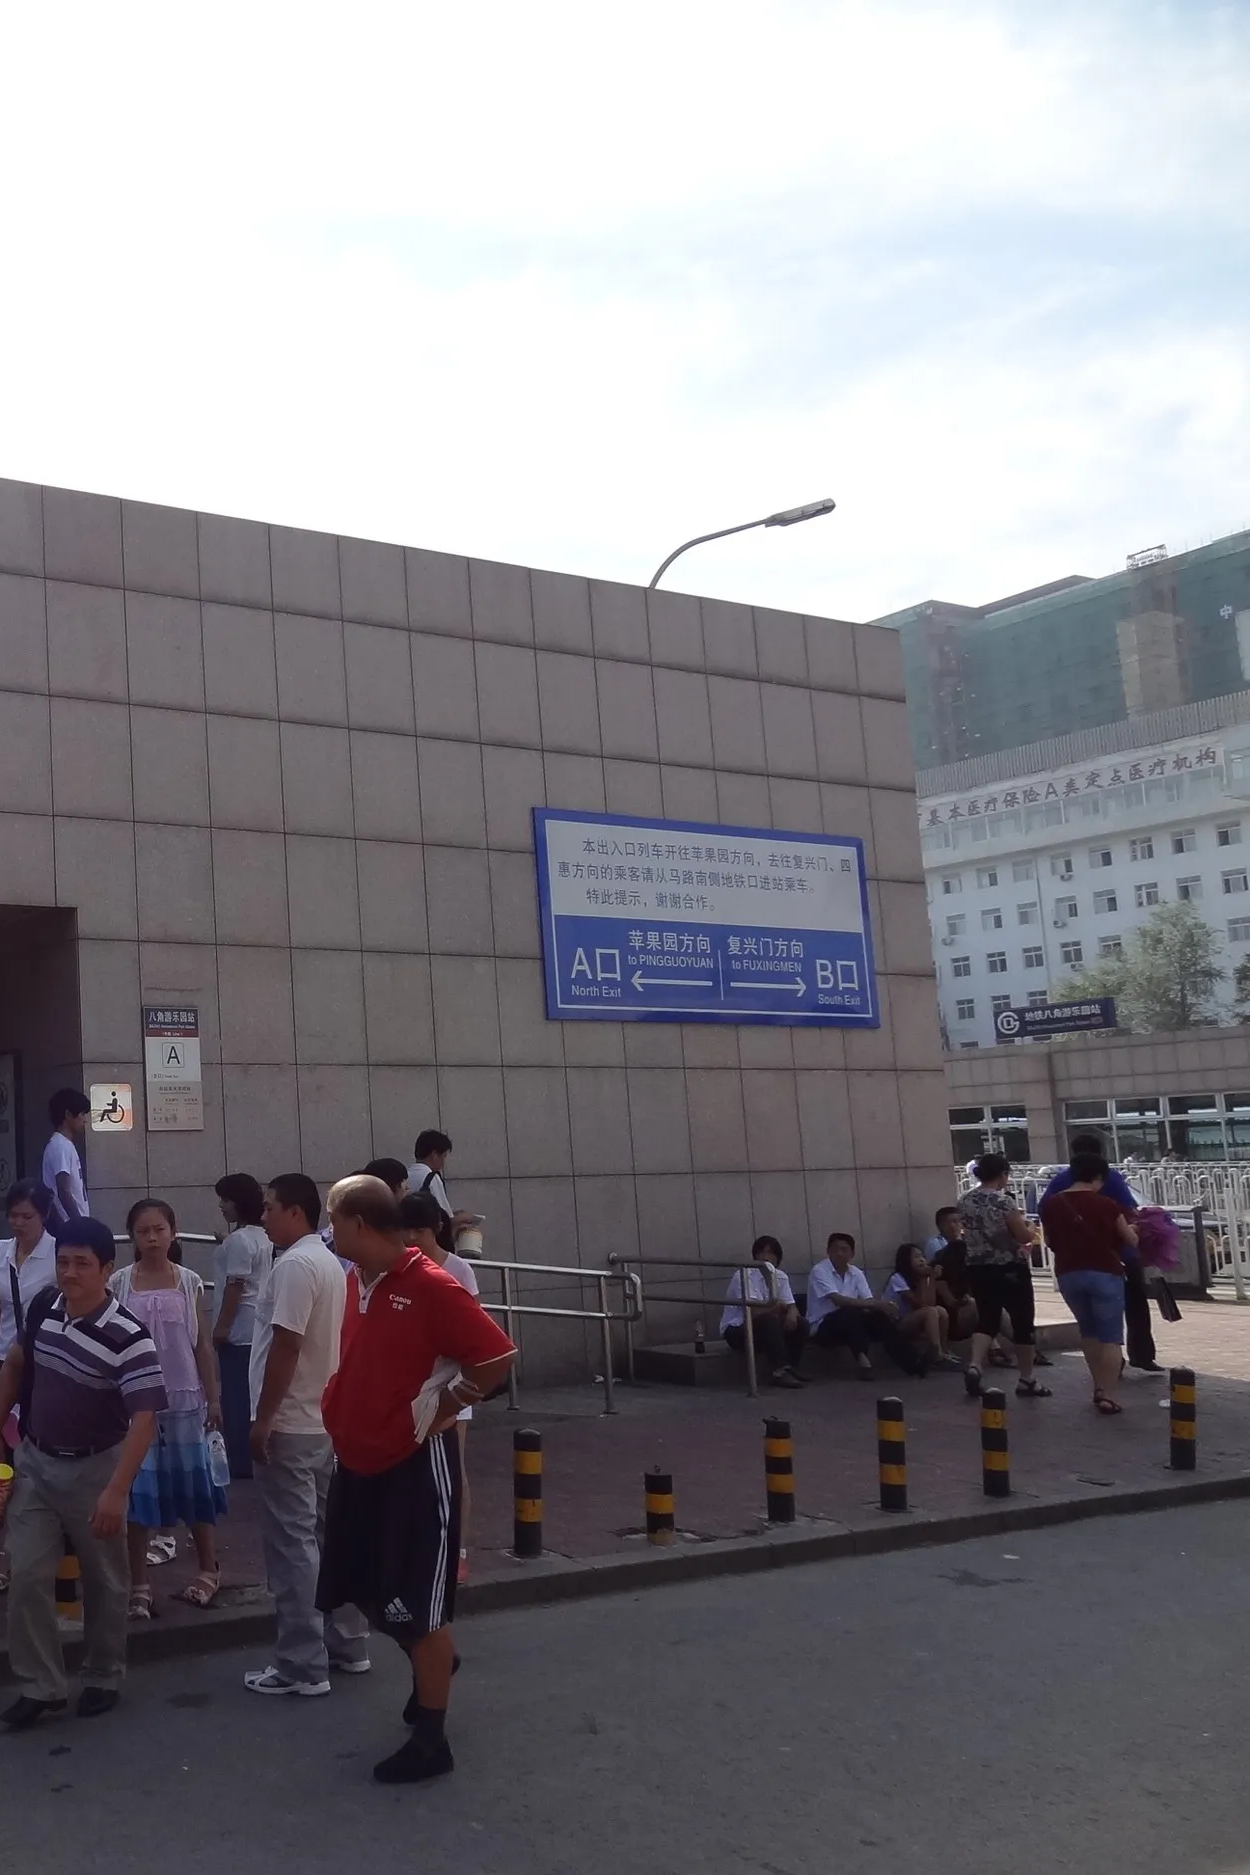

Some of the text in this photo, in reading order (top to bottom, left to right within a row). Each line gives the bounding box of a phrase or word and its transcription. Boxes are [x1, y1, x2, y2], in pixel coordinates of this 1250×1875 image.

[917, 746, 1218, 827] 基本医疗保险A类定点医疗机构
[628, 929, 711, 954] 苹果园方向
[727, 935, 804, 958] 复兴门方向
[570, 947, 621, 982] A口
[628, 954, 714, 969] to PINGGUOYUAN
[732, 959, 802, 973] to FUXINGMEN
[815, 959, 859, 991] B口
[571, 984, 622, 998] North Exit
[818, 993, 861, 1006] South Exit
[148, 1010, 195, 1023] 八角游乐园站
[166, 1045, 181, 1065] A
[389, 1293, 412, 1305] Canon
